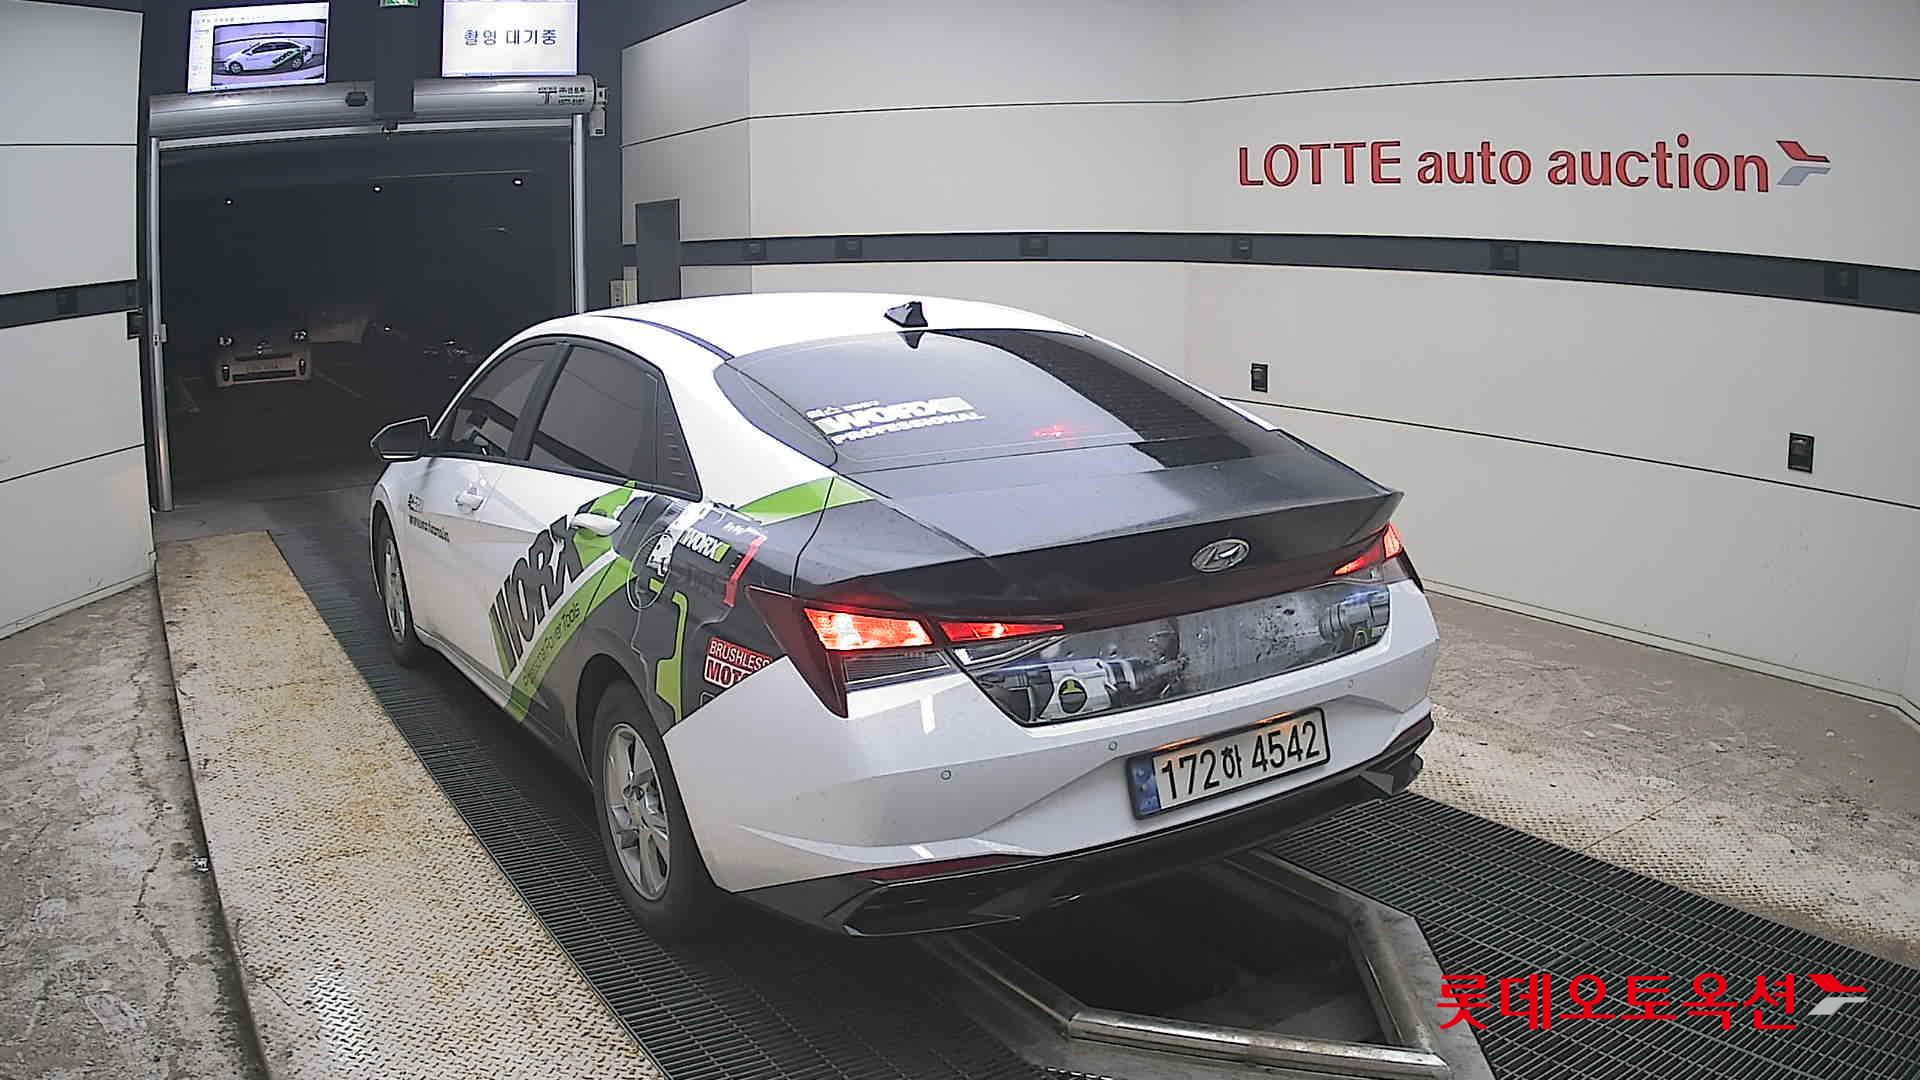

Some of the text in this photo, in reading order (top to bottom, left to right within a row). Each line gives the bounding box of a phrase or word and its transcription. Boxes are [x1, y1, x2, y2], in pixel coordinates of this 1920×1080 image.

[505, 29, 557, 46] 대기중
[1239, 132, 1770, 193] LOTTE auto auction
[679, 527, 723, 561] WORX
[1161, 721, 1321, 800] 172하 4542
